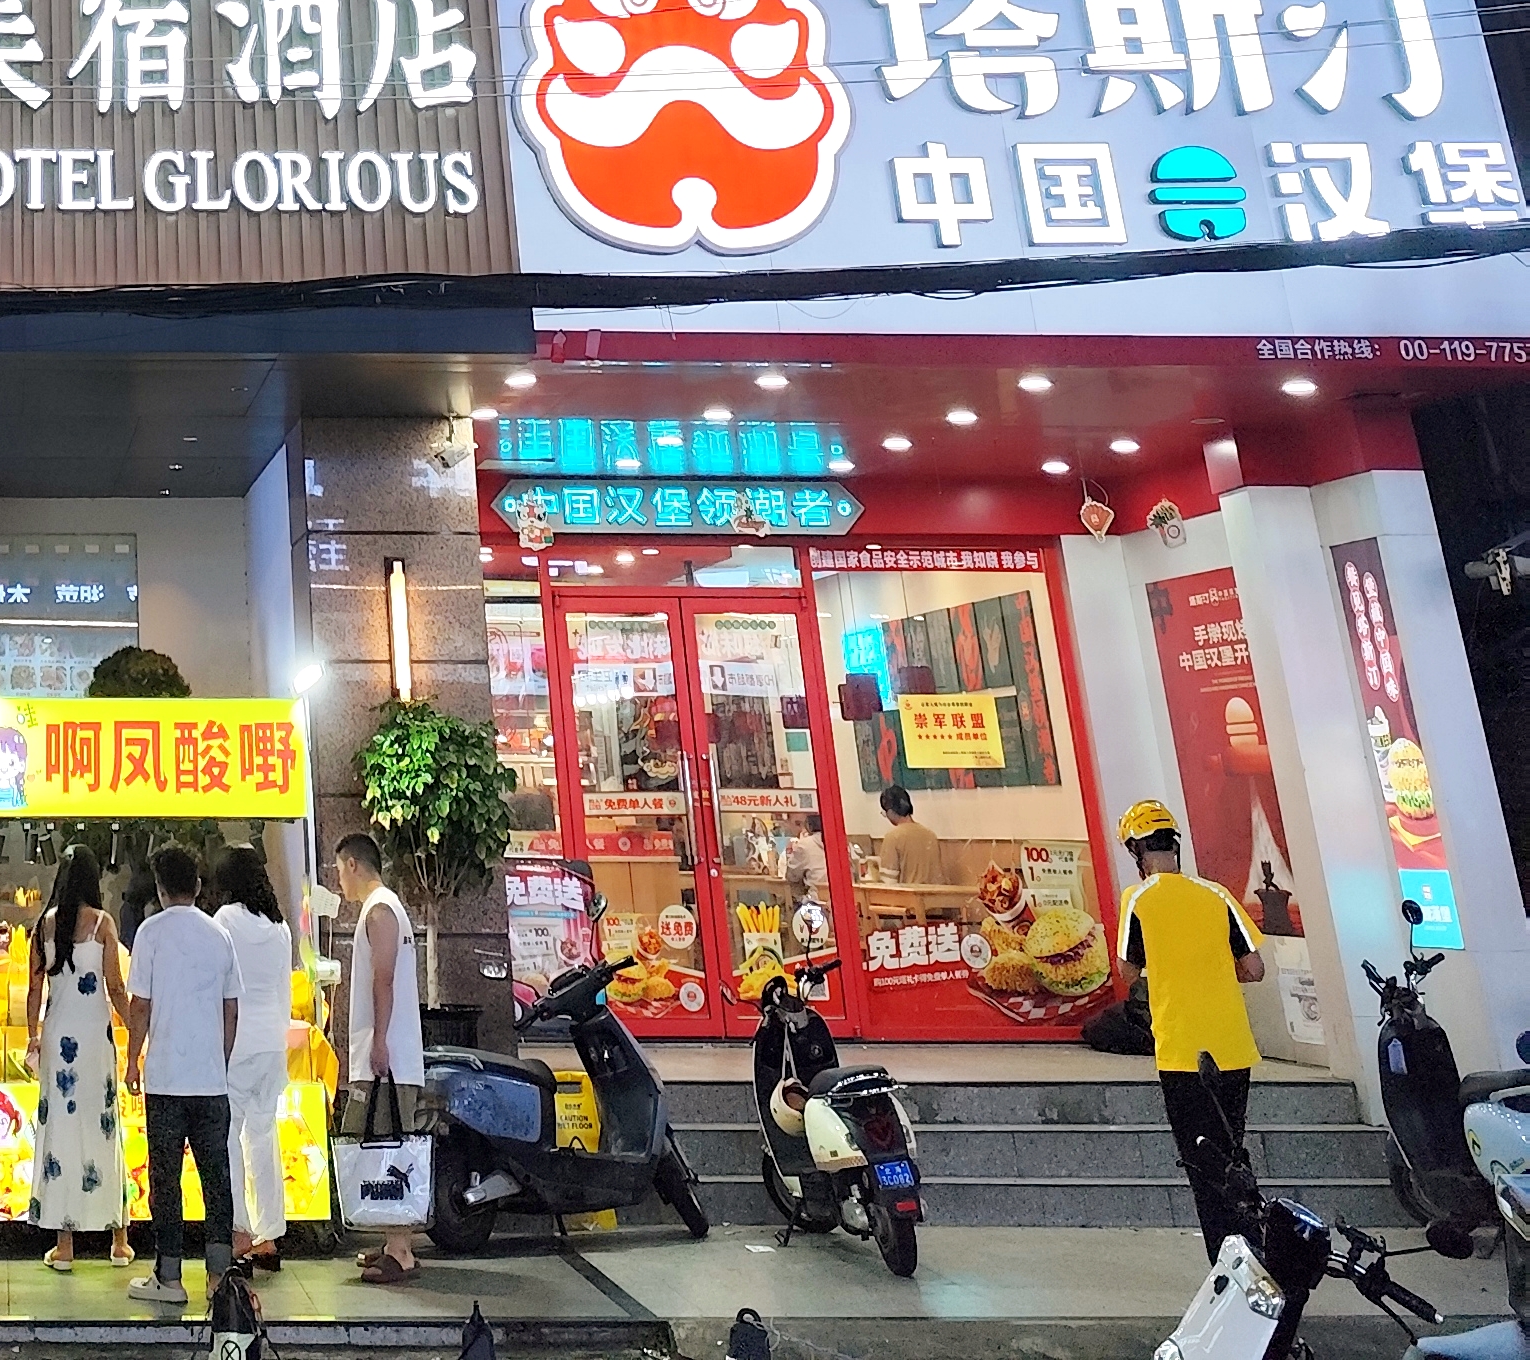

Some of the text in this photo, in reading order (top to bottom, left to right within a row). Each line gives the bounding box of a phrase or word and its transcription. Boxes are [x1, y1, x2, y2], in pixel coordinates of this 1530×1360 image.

[144, 149, 480, 214] GLORIOUS
[914, 712, 986, 729] 崇军联盟
[46, 720, 297, 795] 啊凤酸嘢
[1024, 846, 1050, 863] 100
[868, 922, 962, 972] 免费送
